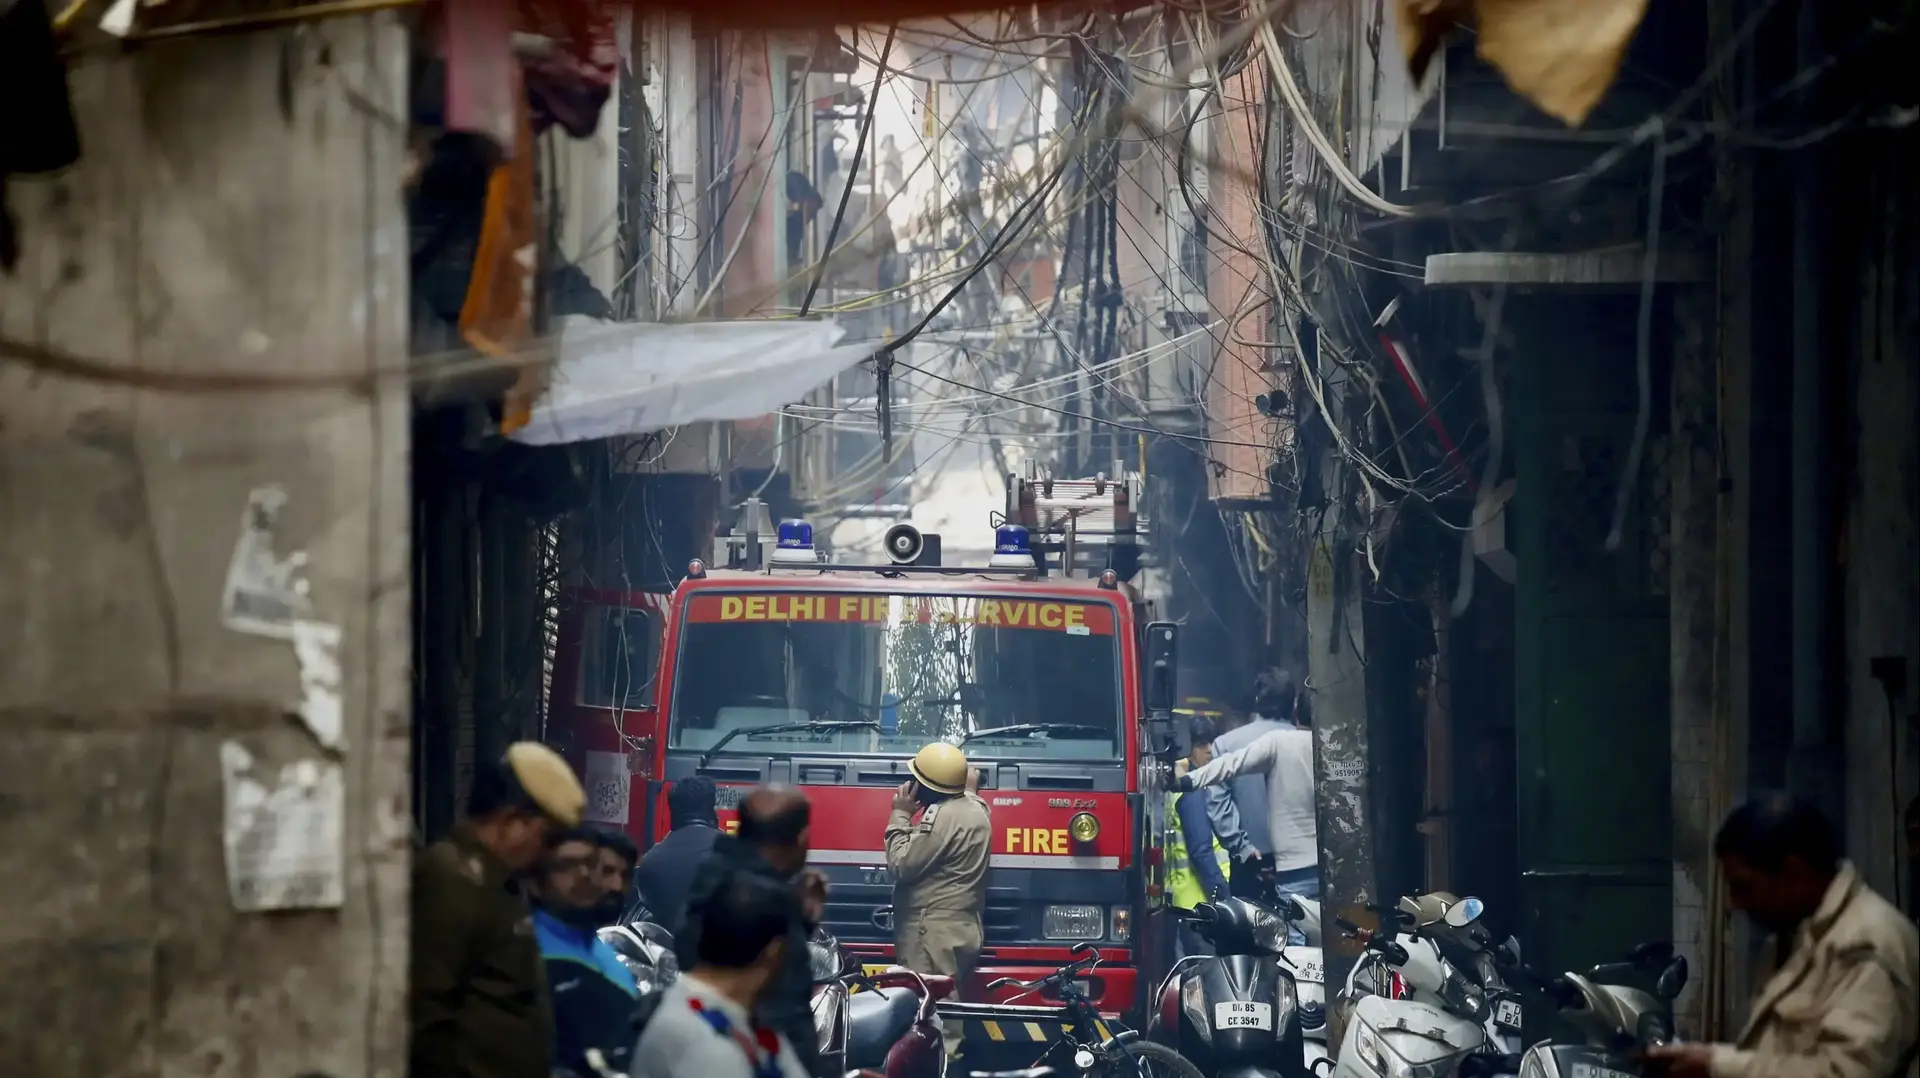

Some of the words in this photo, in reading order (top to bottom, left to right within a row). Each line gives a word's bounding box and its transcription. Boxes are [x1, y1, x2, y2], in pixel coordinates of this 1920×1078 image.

[720, 596, 826, 620] DELHI
[1006, 827, 1069, 854] FIRE
[1307, 963, 1317, 971] DL
[1245, 1003, 1255, 1012] 8S
[1228, 1016, 1239, 1026] CE
[1240, 1016, 1260, 1026] 3547
